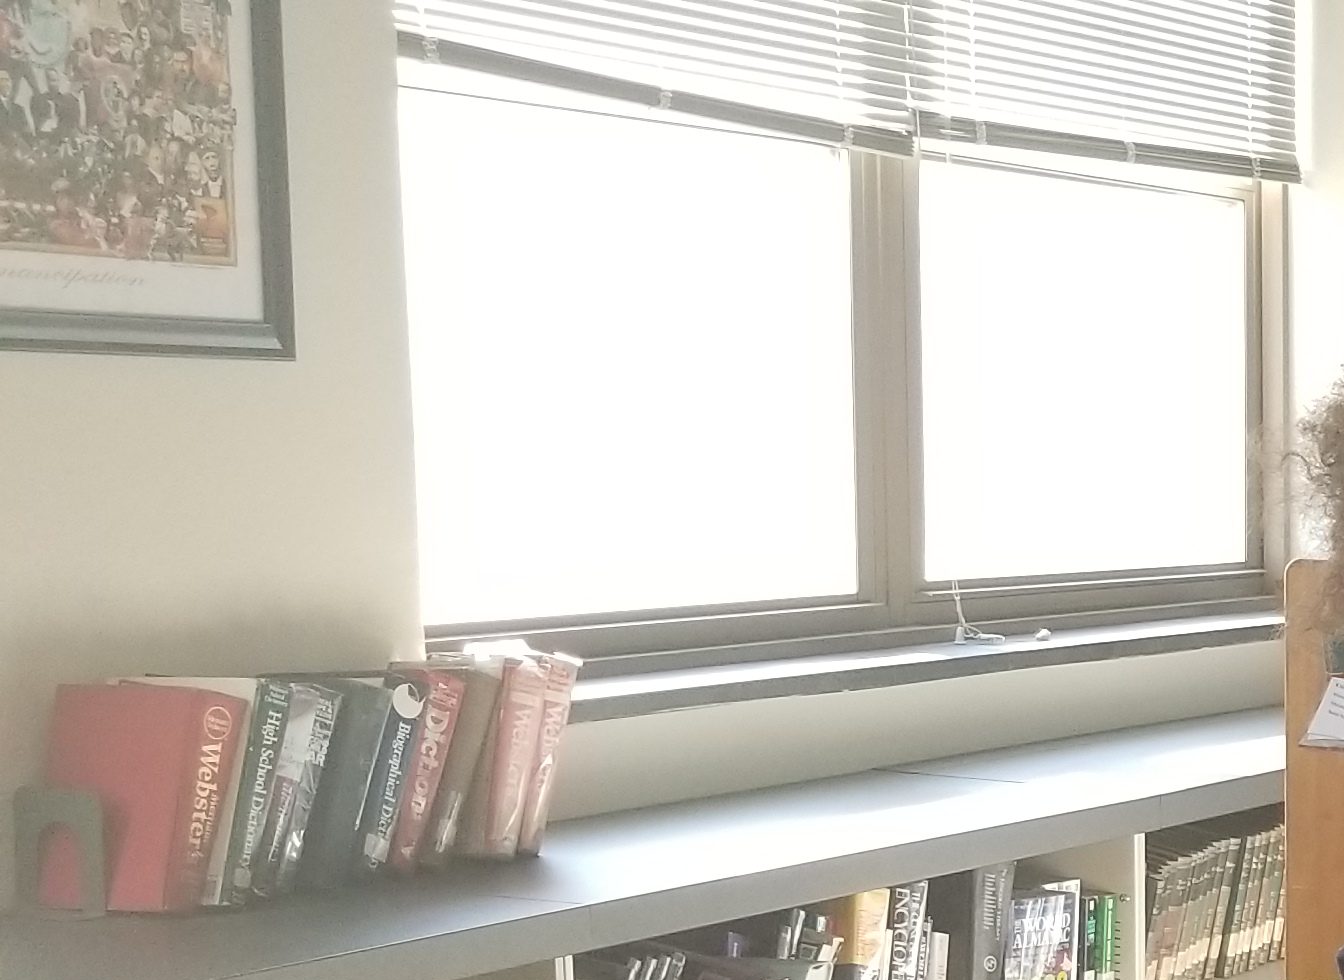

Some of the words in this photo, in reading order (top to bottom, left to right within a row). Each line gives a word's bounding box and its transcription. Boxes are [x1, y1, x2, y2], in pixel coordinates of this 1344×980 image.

[260, 709, 283, 746] High
[253, 747, 275, 796] School
[383, 721, 412, 804] Biographical
[239, 794, 265, 869] Dictionary
[1012, 926, 1071, 949] ALMANC
[1021, 912, 1072, 934] WORD
